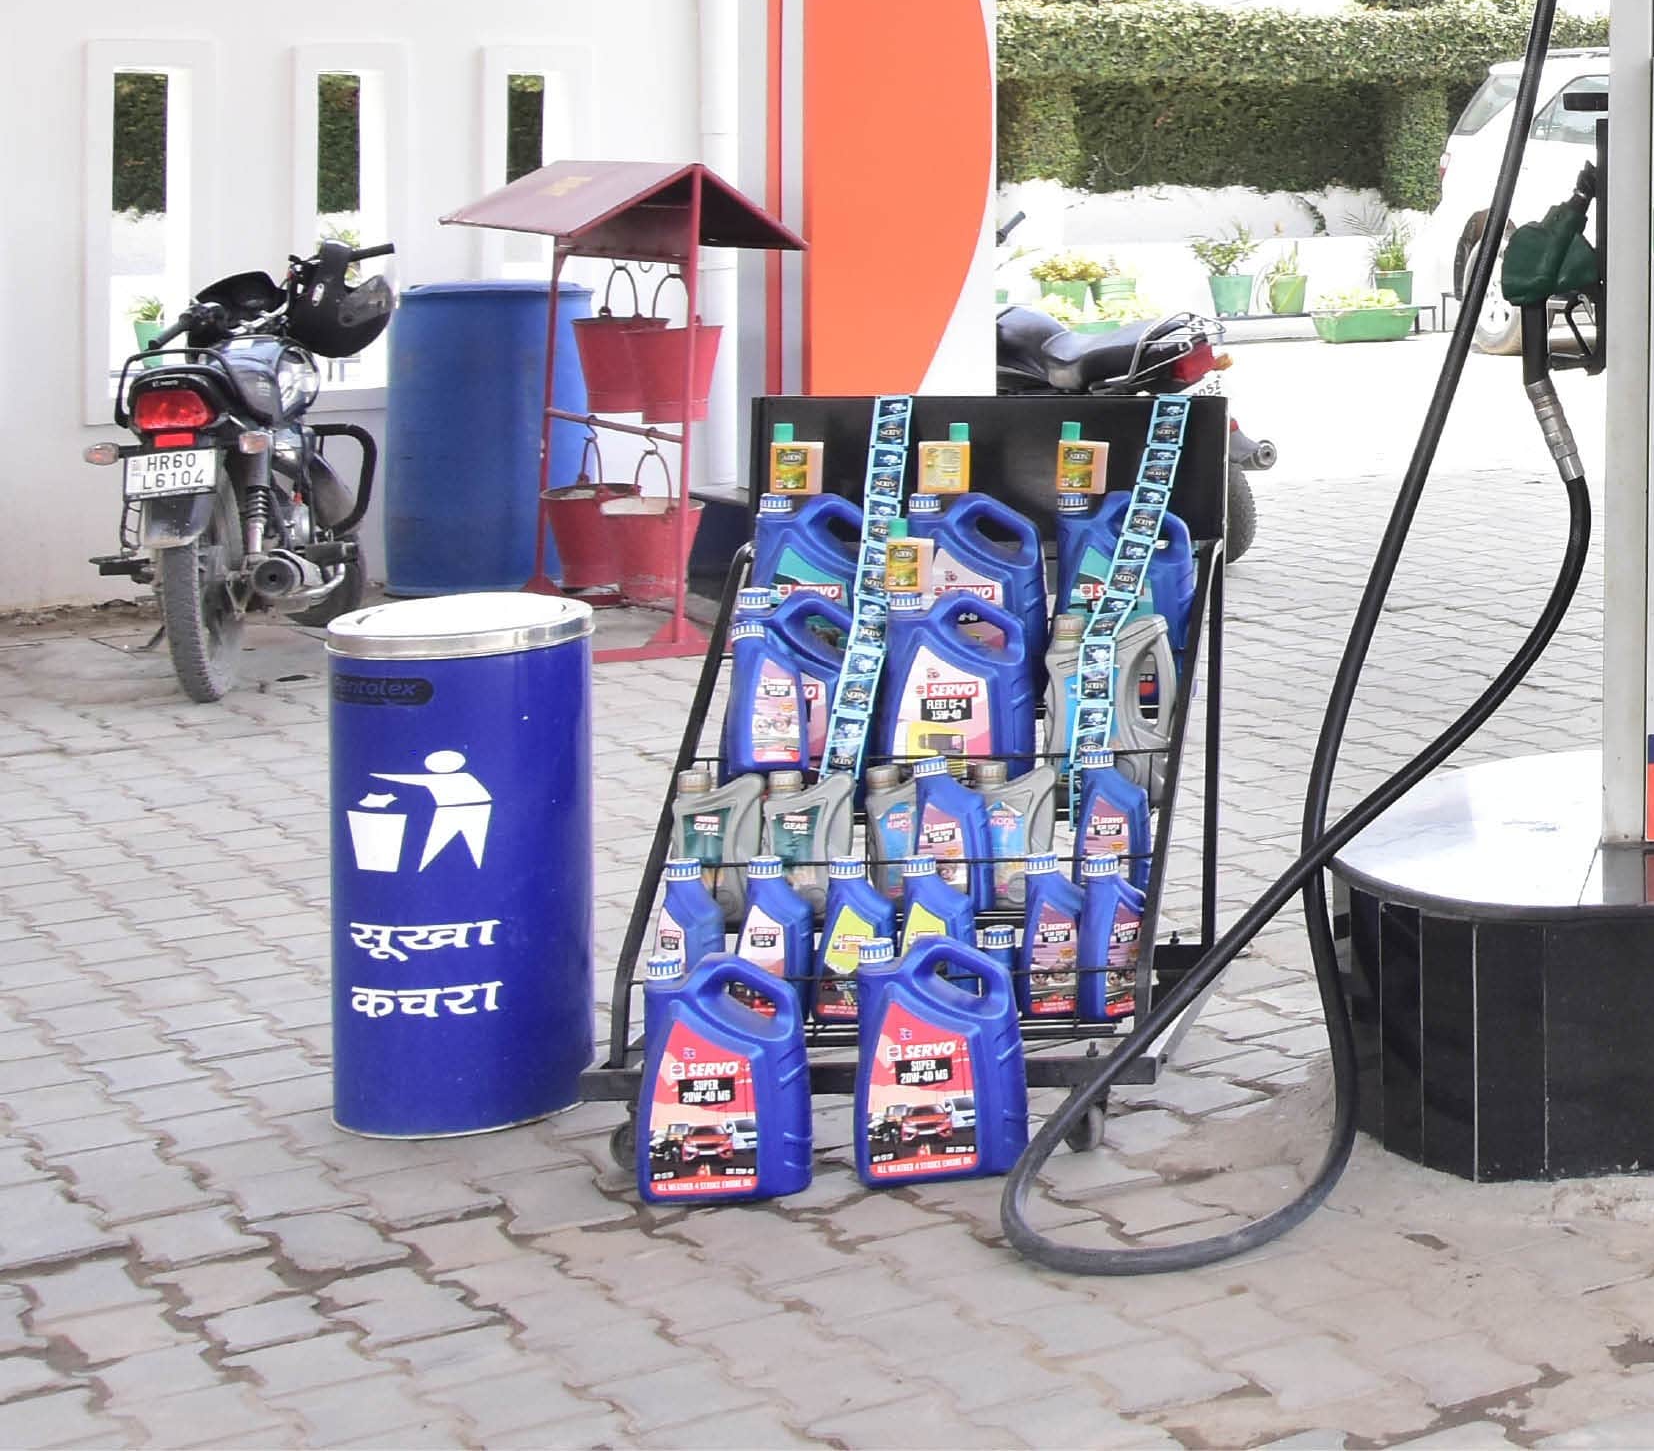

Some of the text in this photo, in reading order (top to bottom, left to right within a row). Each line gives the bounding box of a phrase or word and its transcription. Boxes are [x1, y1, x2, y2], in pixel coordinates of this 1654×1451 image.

[146, 453, 196, 471] HR60
[142, 469, 204, 490] L6104
[929, 683, 977, 696] SERVO
[926, 699, 947, 710] FLEET
[694, 823, 719, 832] GEAR
[783, 822, 809, 831] GEAR
[1047, 922, 1072, 931] SERVO
[349, 918, 501, 962] सूखा
[350, 980, 503, 1019] कचरा
[905, 1041, 957, 1059] SERVO
[687, 1061, 739, 1077] SERVO
[911, 1059, 936, 1072] SUPER
[900, 1071, 934, 1085] 20W-40
[693, 1079, 719, 1091] SUPER
[682, 1090, 716, 1103] 20W-40
